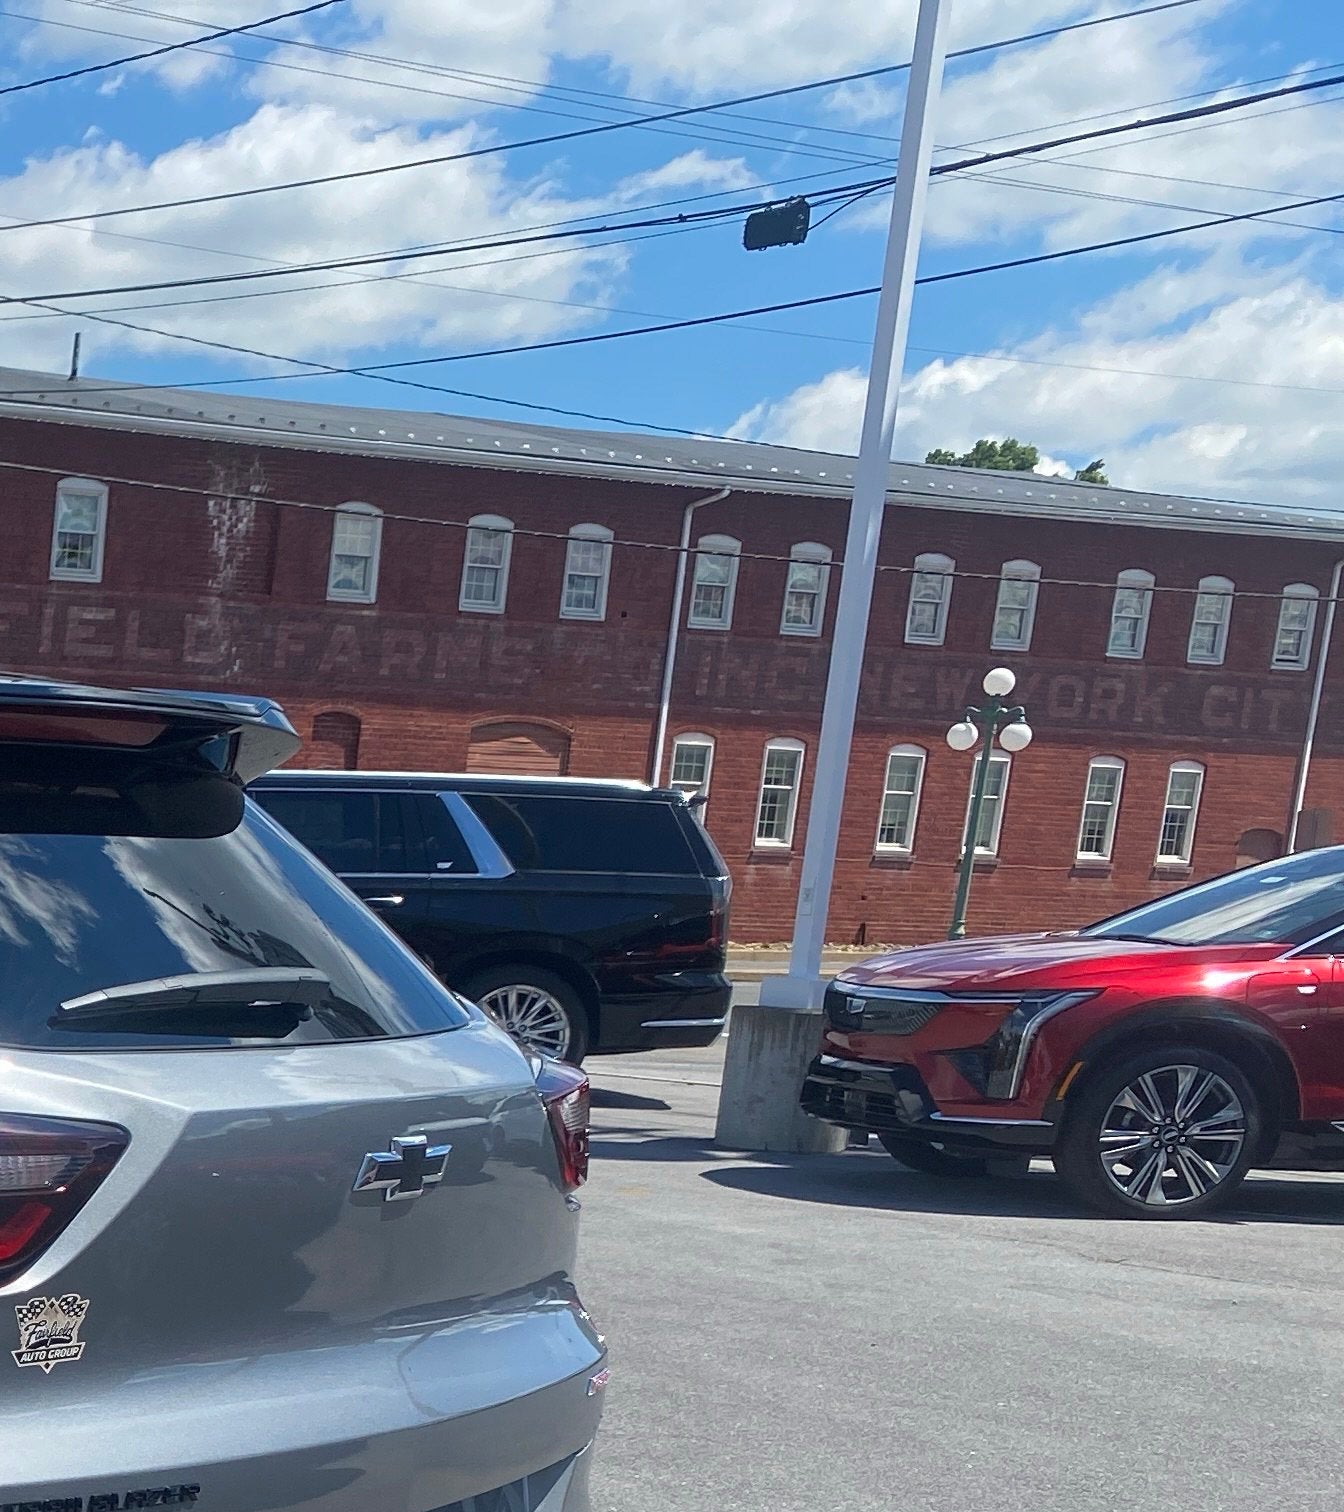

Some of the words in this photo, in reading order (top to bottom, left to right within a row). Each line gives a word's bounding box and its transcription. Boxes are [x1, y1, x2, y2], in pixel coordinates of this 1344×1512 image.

[23, 1320, 79, 1348] Fairfield
[20, 1350, 47, 1362] AUTO
[48, 1346, 80, 1359] GROUP
